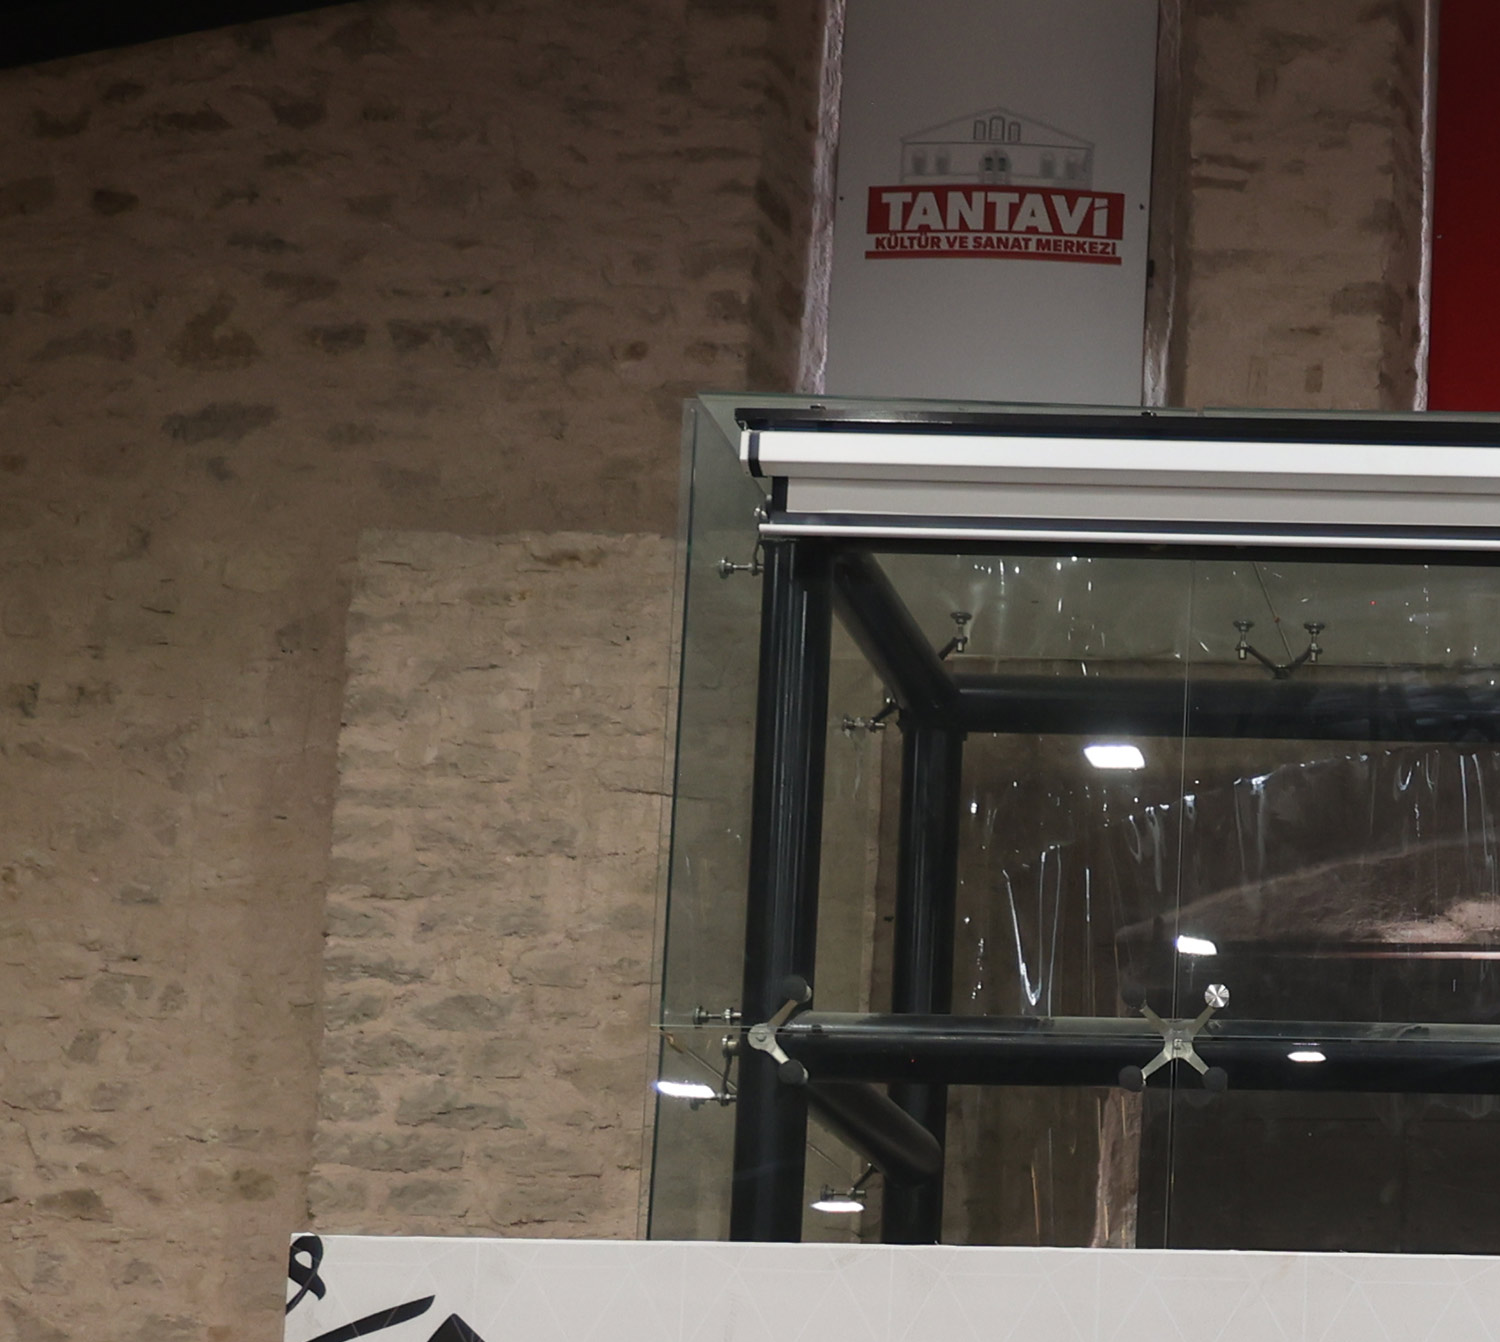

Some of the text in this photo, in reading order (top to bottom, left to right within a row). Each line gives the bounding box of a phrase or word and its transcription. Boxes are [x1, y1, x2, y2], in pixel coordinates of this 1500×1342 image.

[875, 233, 940, 250] KÜLTÜR
[945, 236, 968, 249] VE
[972, 236, 1033, 251] SANAT
